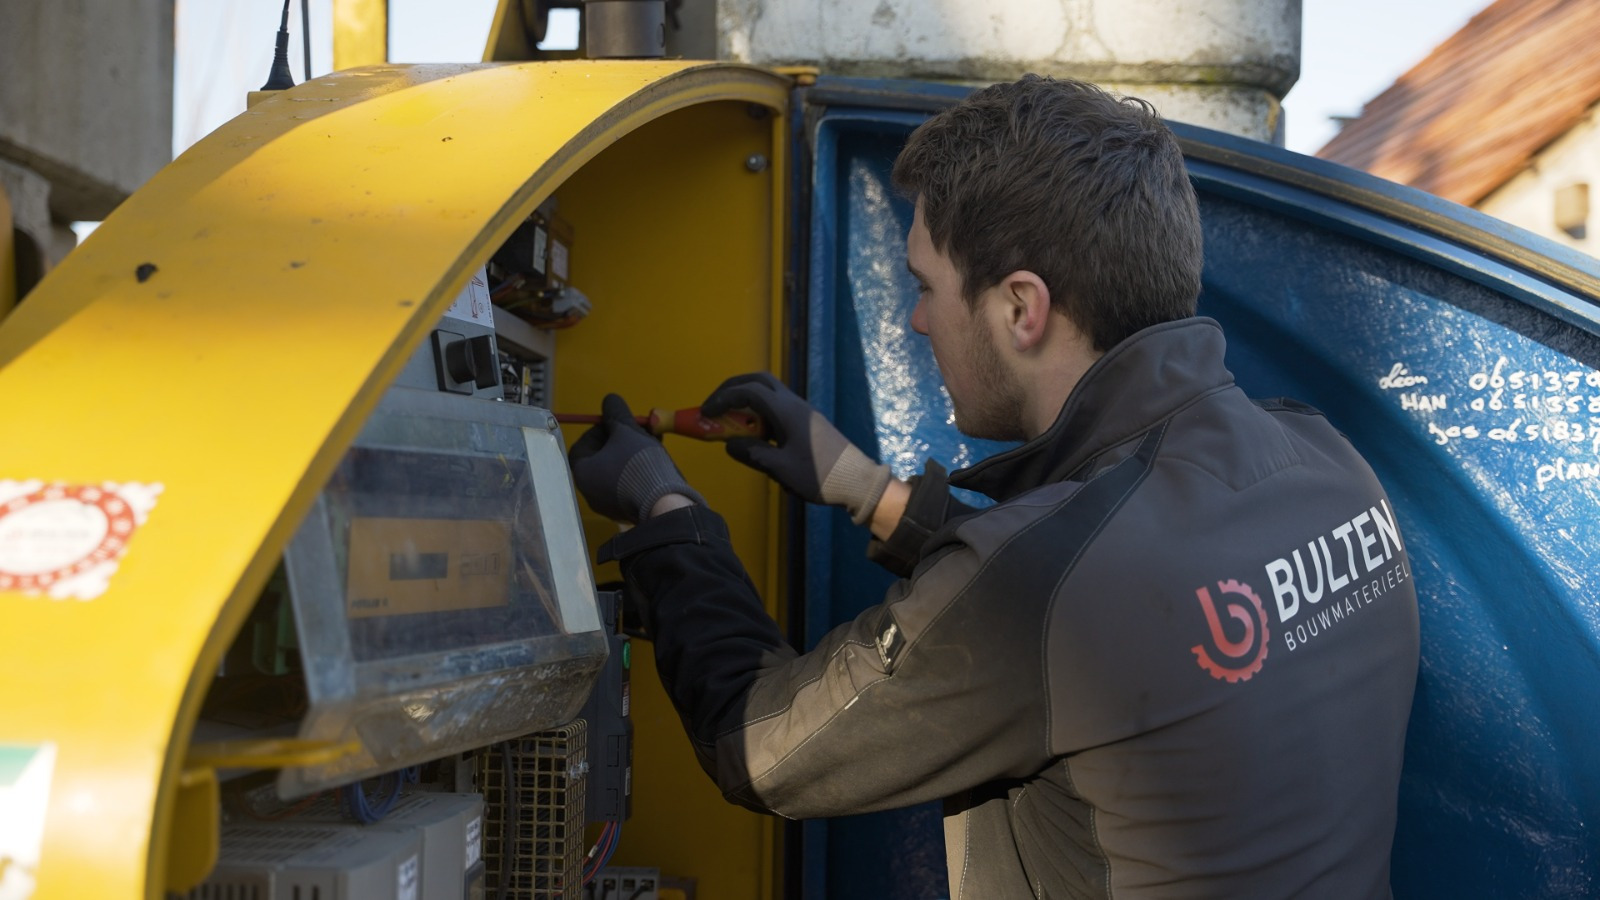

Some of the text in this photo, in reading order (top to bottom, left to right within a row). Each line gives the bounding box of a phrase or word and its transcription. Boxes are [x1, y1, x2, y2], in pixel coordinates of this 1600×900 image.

[1401, 392, 1447, 413] HAN
[1265, 498, 1402, 623] BULTEN
[1284, 561, 1409, 652] BOUWMATERIEEL
